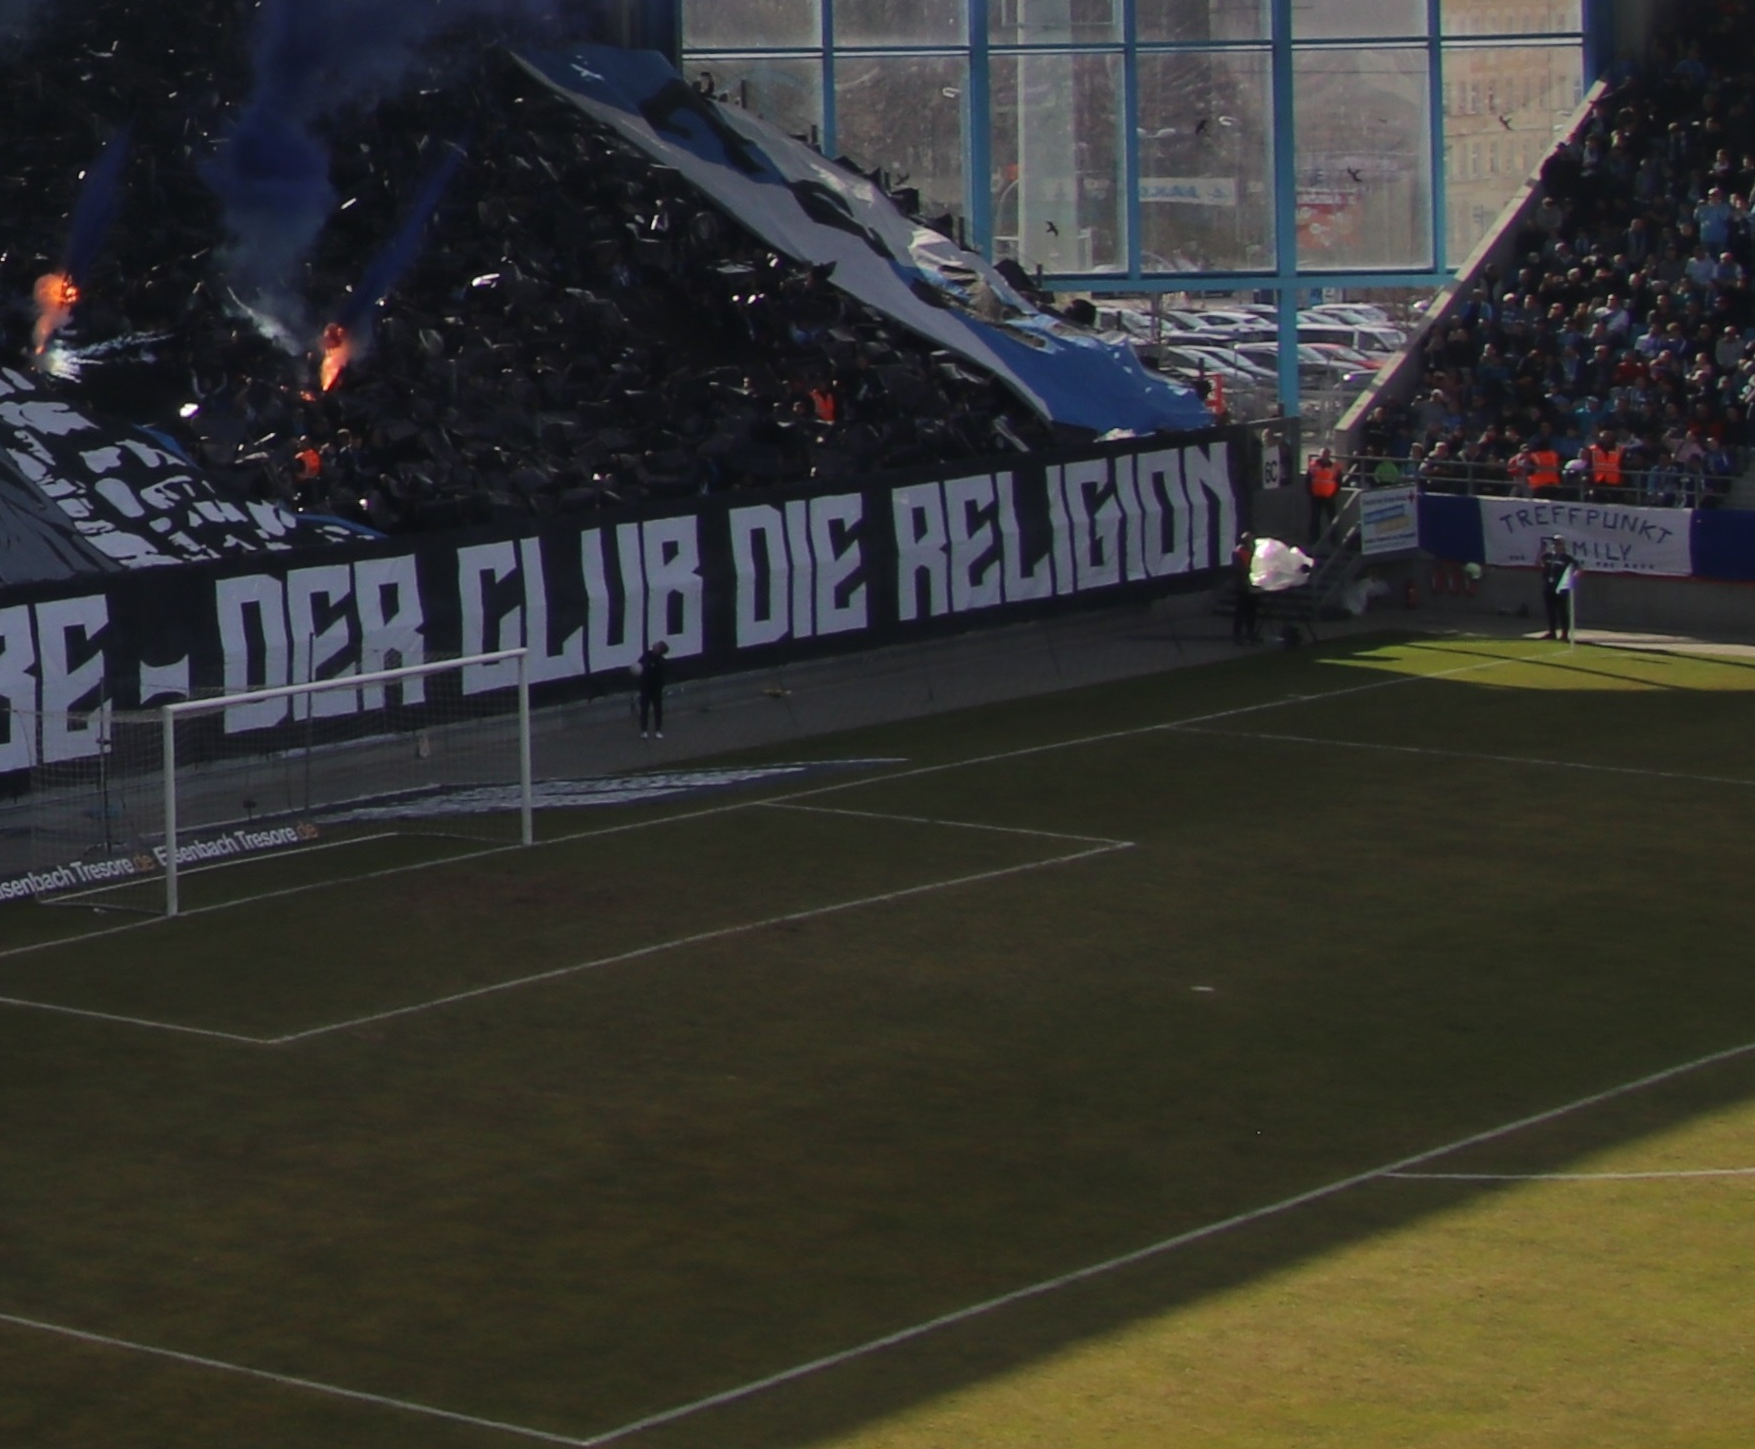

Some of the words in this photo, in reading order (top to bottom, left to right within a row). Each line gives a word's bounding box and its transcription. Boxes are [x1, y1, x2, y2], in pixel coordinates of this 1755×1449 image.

[1499, 505, 1673, 544] TREFFPUNKT
[215, 554, 426, 733] DER
[457, 515, 703, 695] CLUB
[729, 493, 869, 648] DIE
[892, 442, 1237, 621] RELIGION
[152, 832, 241, 866] Esenbach
